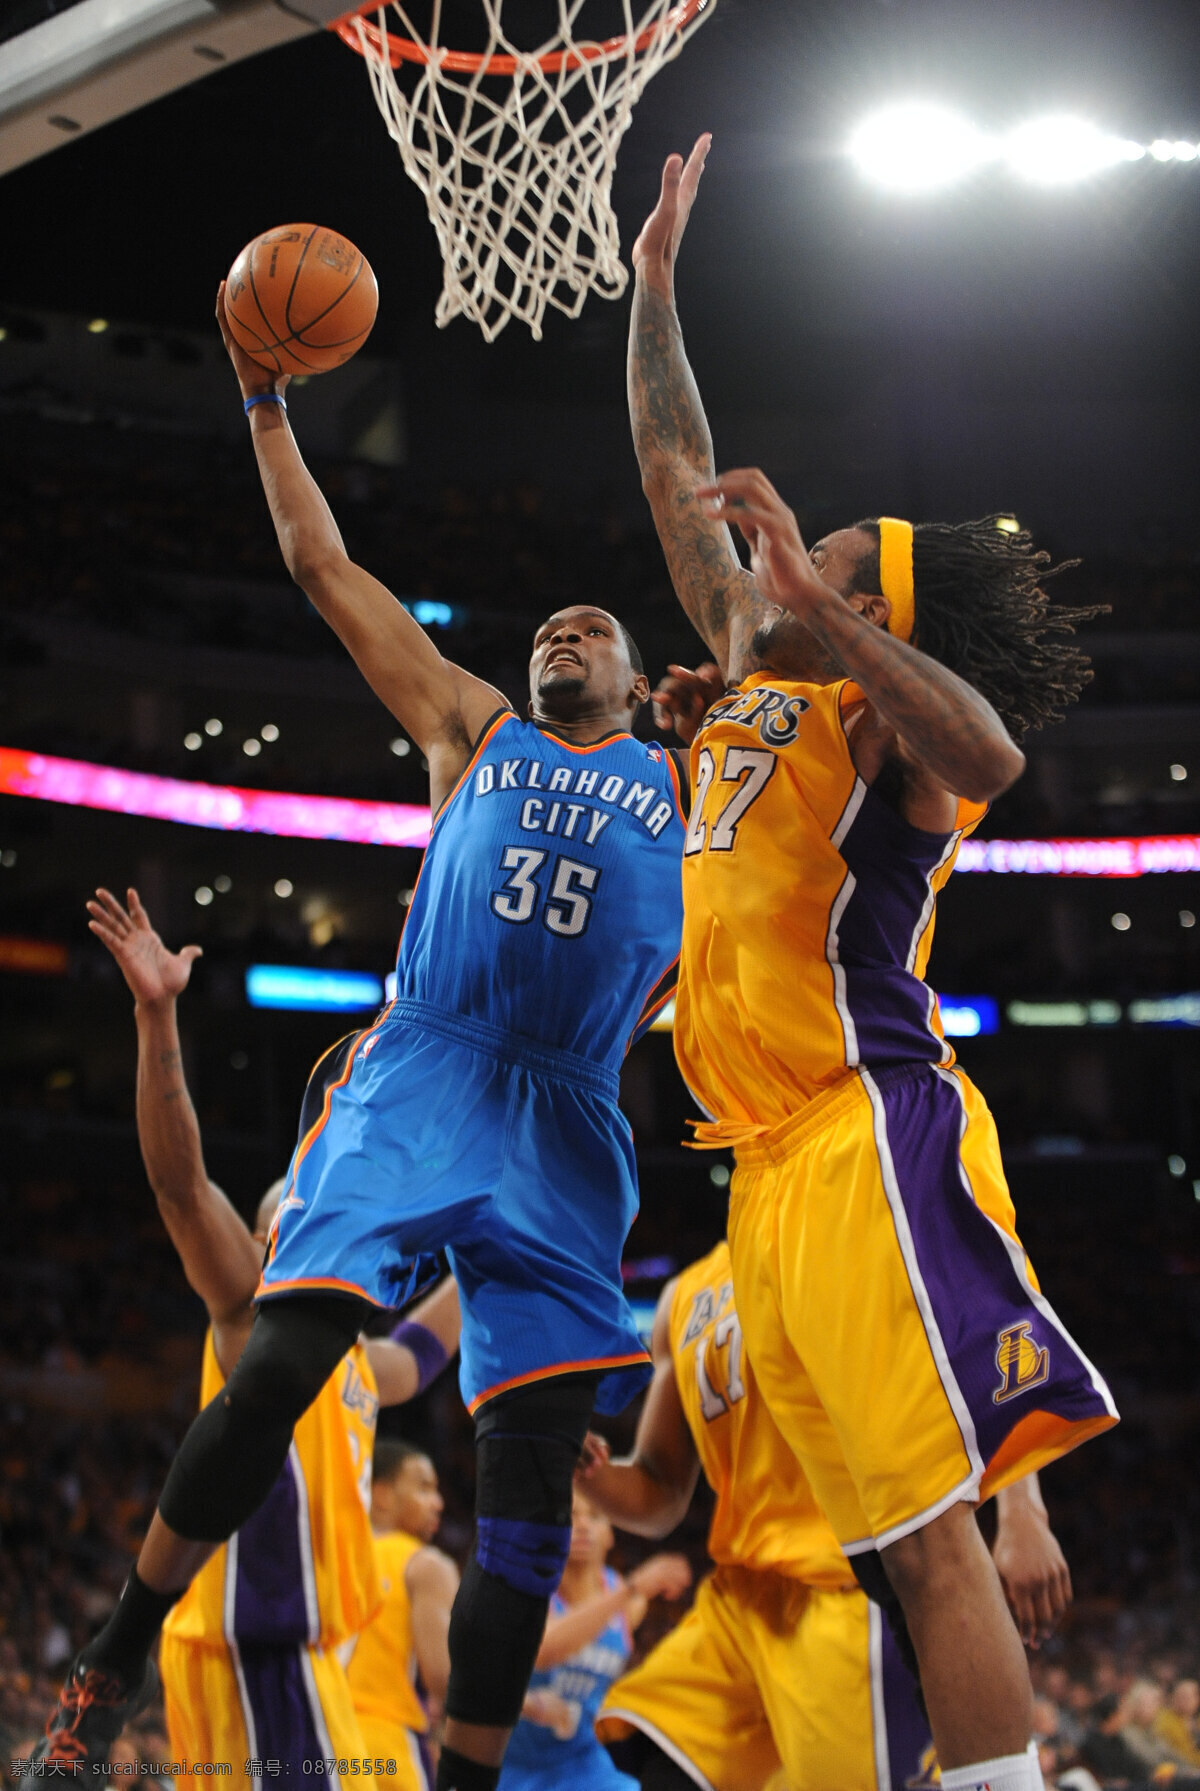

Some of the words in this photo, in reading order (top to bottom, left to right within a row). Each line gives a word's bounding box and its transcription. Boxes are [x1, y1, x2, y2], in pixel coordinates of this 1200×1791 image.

[476, 757, 674, 841] OKLAHOMA
[520, 798, 613, 847] CITY
[684, 746, 778, 857] 27
[490, 845, 602, 939] 35
[696, 1311, 745, 1424] 17
